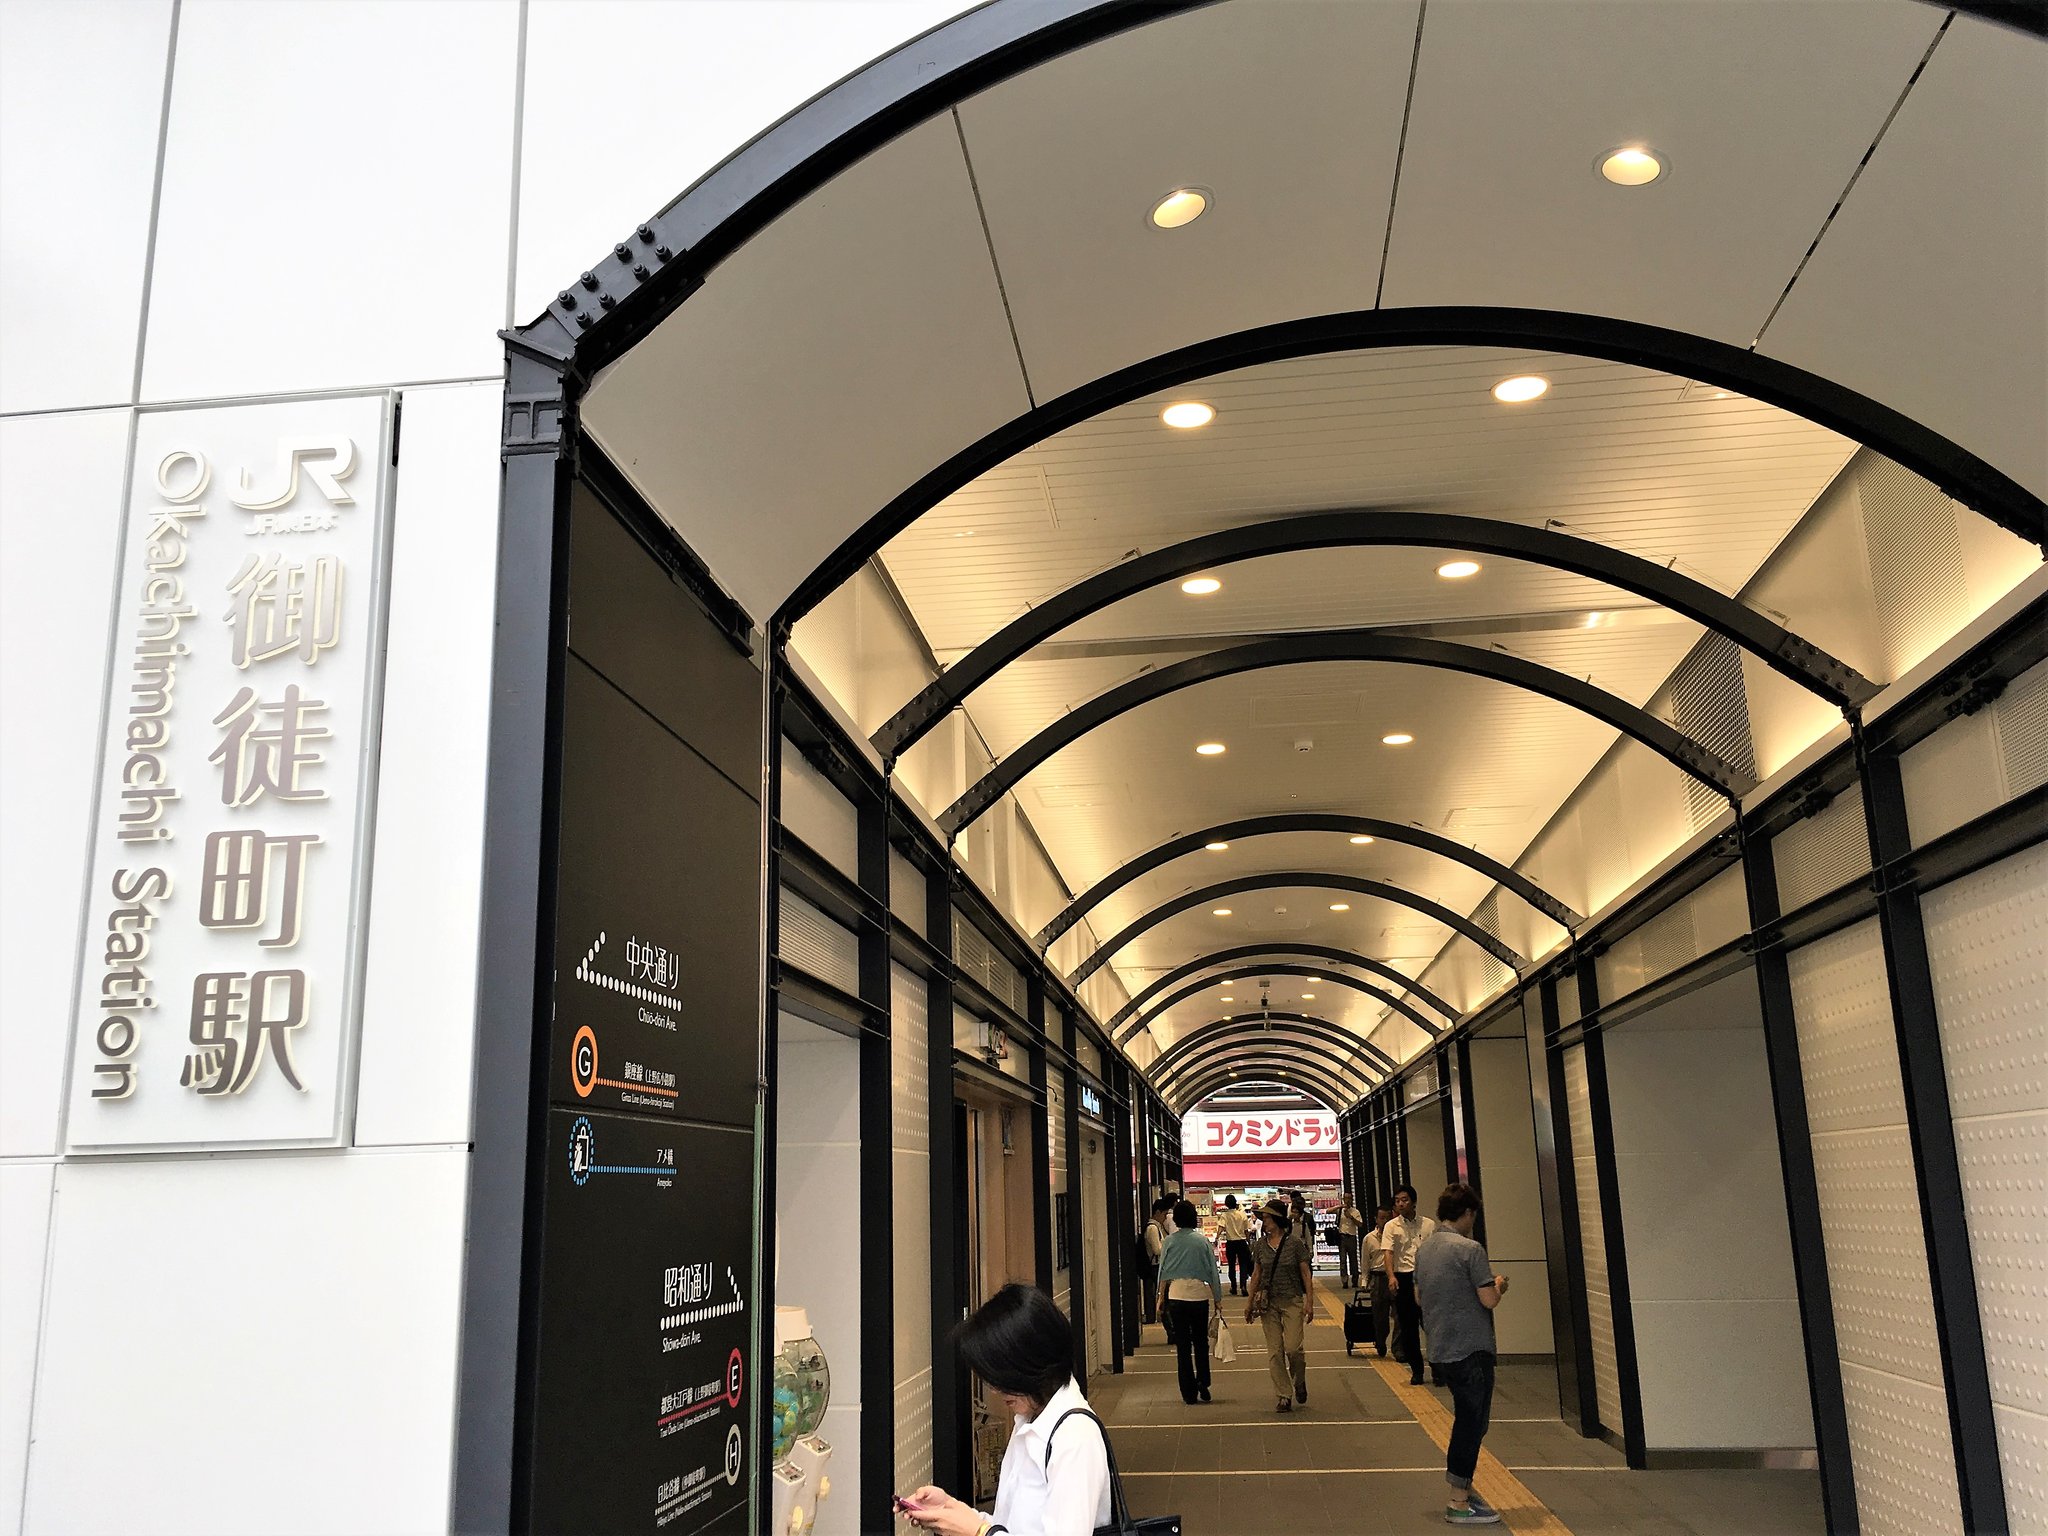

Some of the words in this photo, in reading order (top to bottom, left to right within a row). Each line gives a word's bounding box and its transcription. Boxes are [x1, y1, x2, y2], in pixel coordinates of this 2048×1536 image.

[119, 448, 211, 846] Okachimachi
[180, 552, 345, 1095] 御徒町駅
[88, 865, 173, 1103] Station
[626, 935, 680, 990] 中央通り
[578, 1046, 591, 1077] G
[664, 1261, 713, 1308] 昭和通り
[731, 1364, 739, 1392] E
[729, 1440, 738, 1470] H
